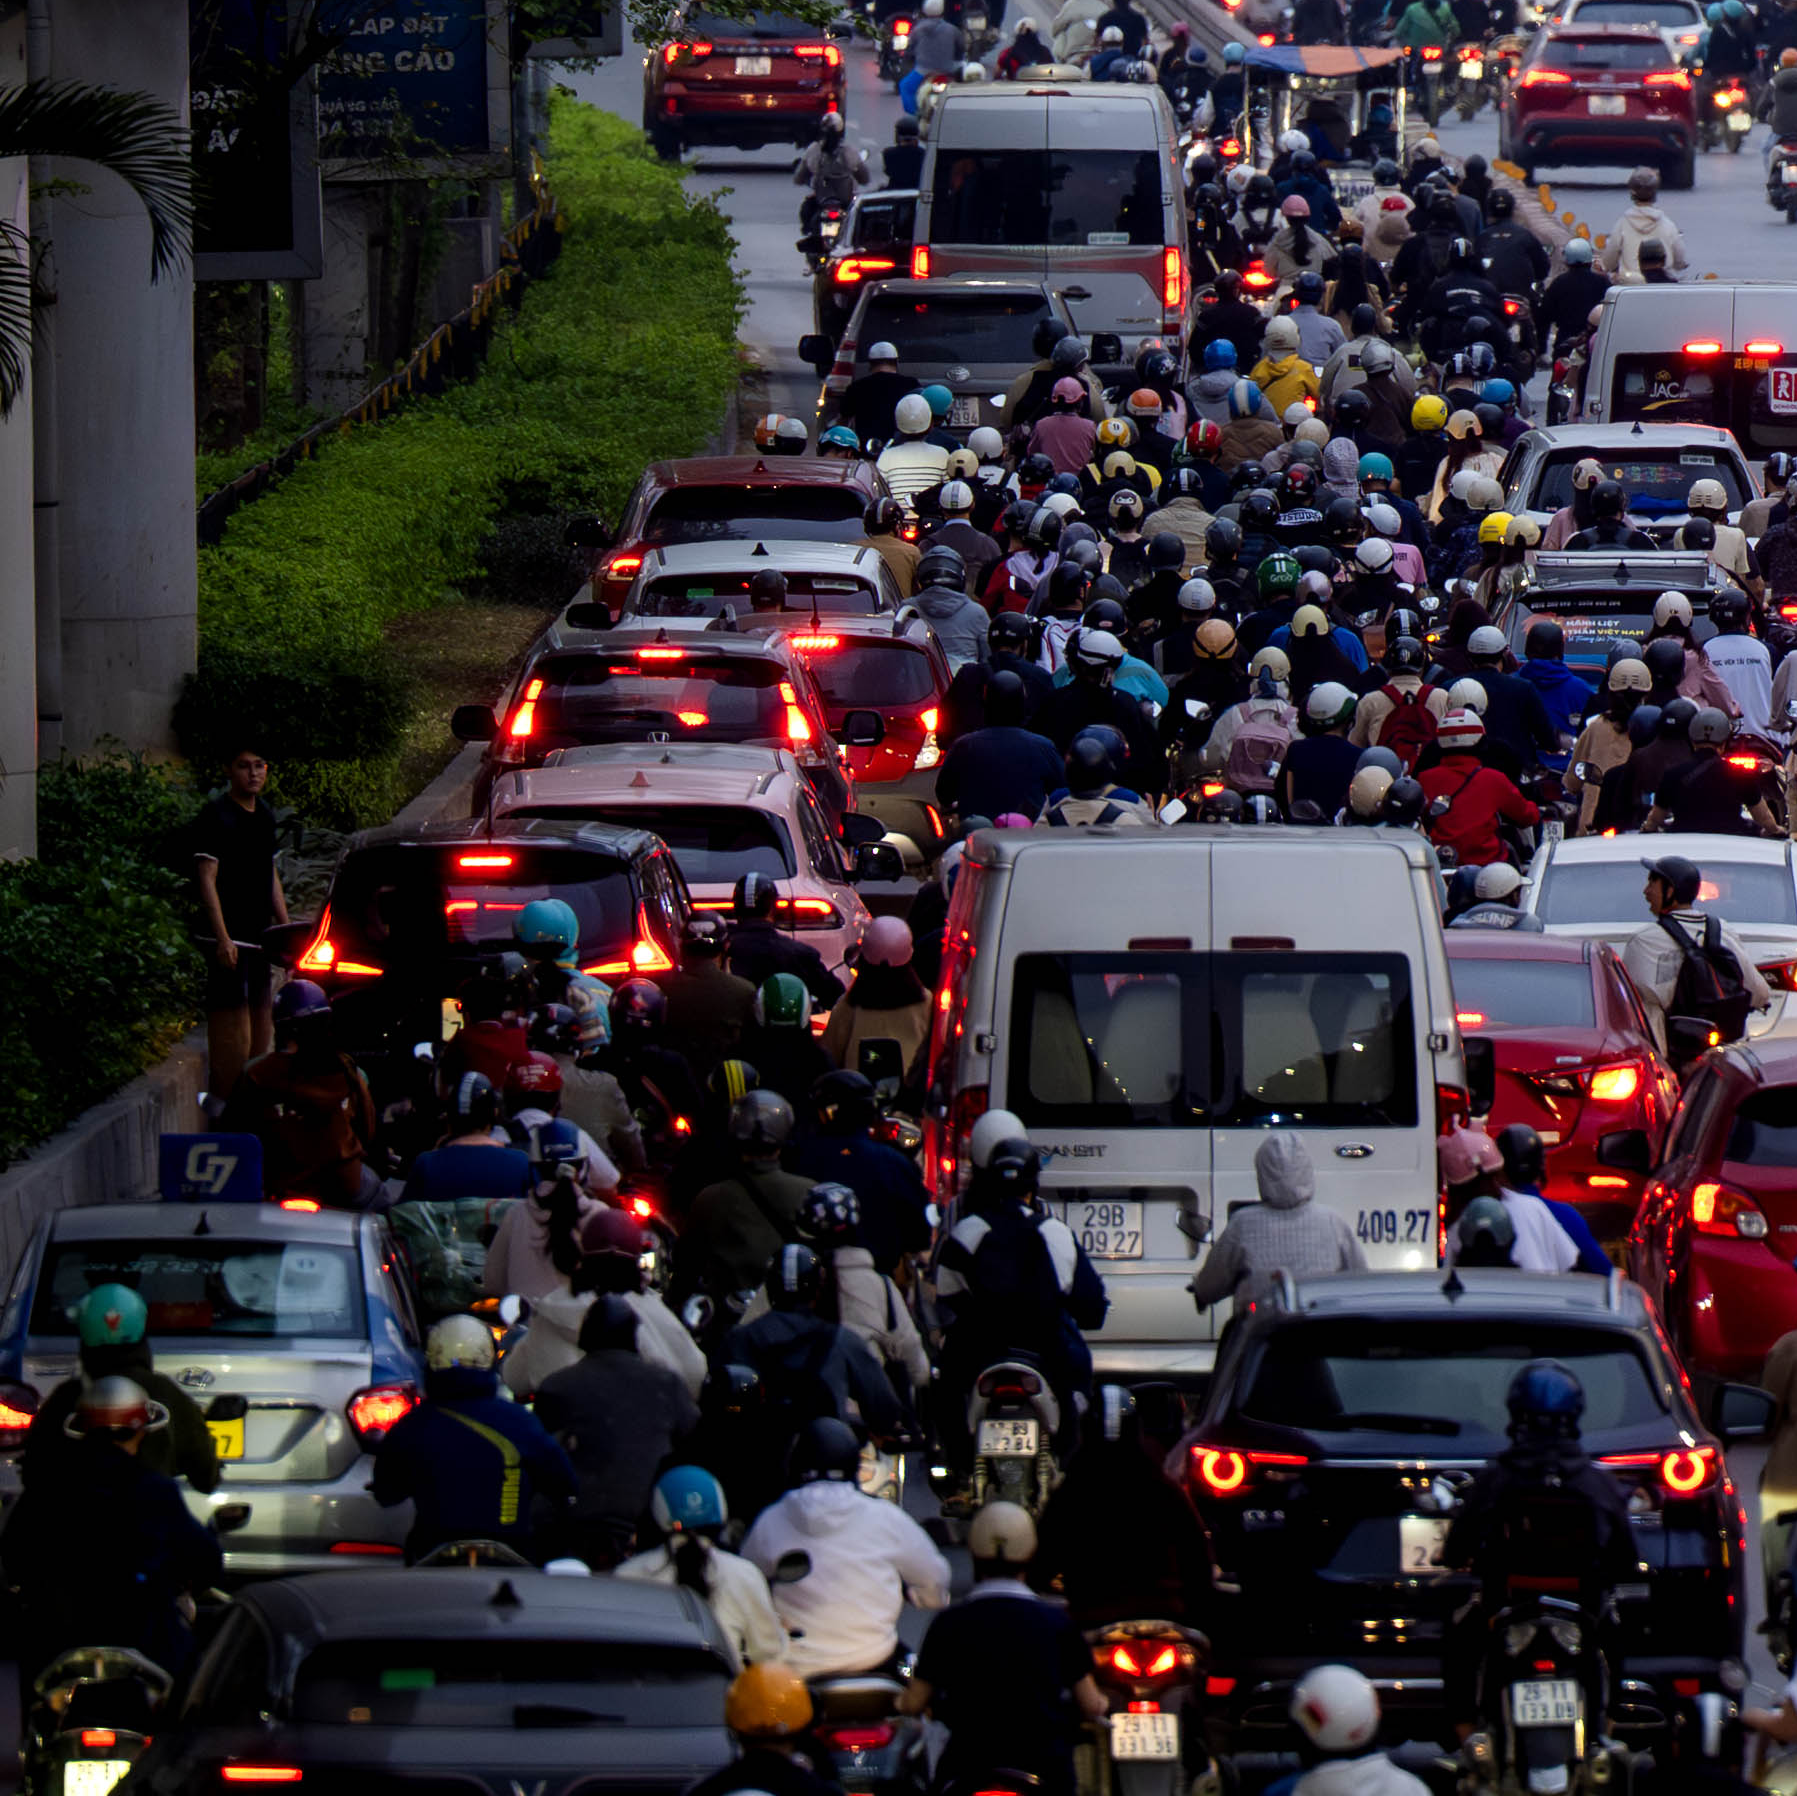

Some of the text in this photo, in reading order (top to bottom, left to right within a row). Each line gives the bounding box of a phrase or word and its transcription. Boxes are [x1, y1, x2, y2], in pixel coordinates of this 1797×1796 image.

[1650, 382, 1680, 399] JAC
[1084, 1203, 1124, 1228] 29B
[1357, 1208, 1431, 1245] 409.27
